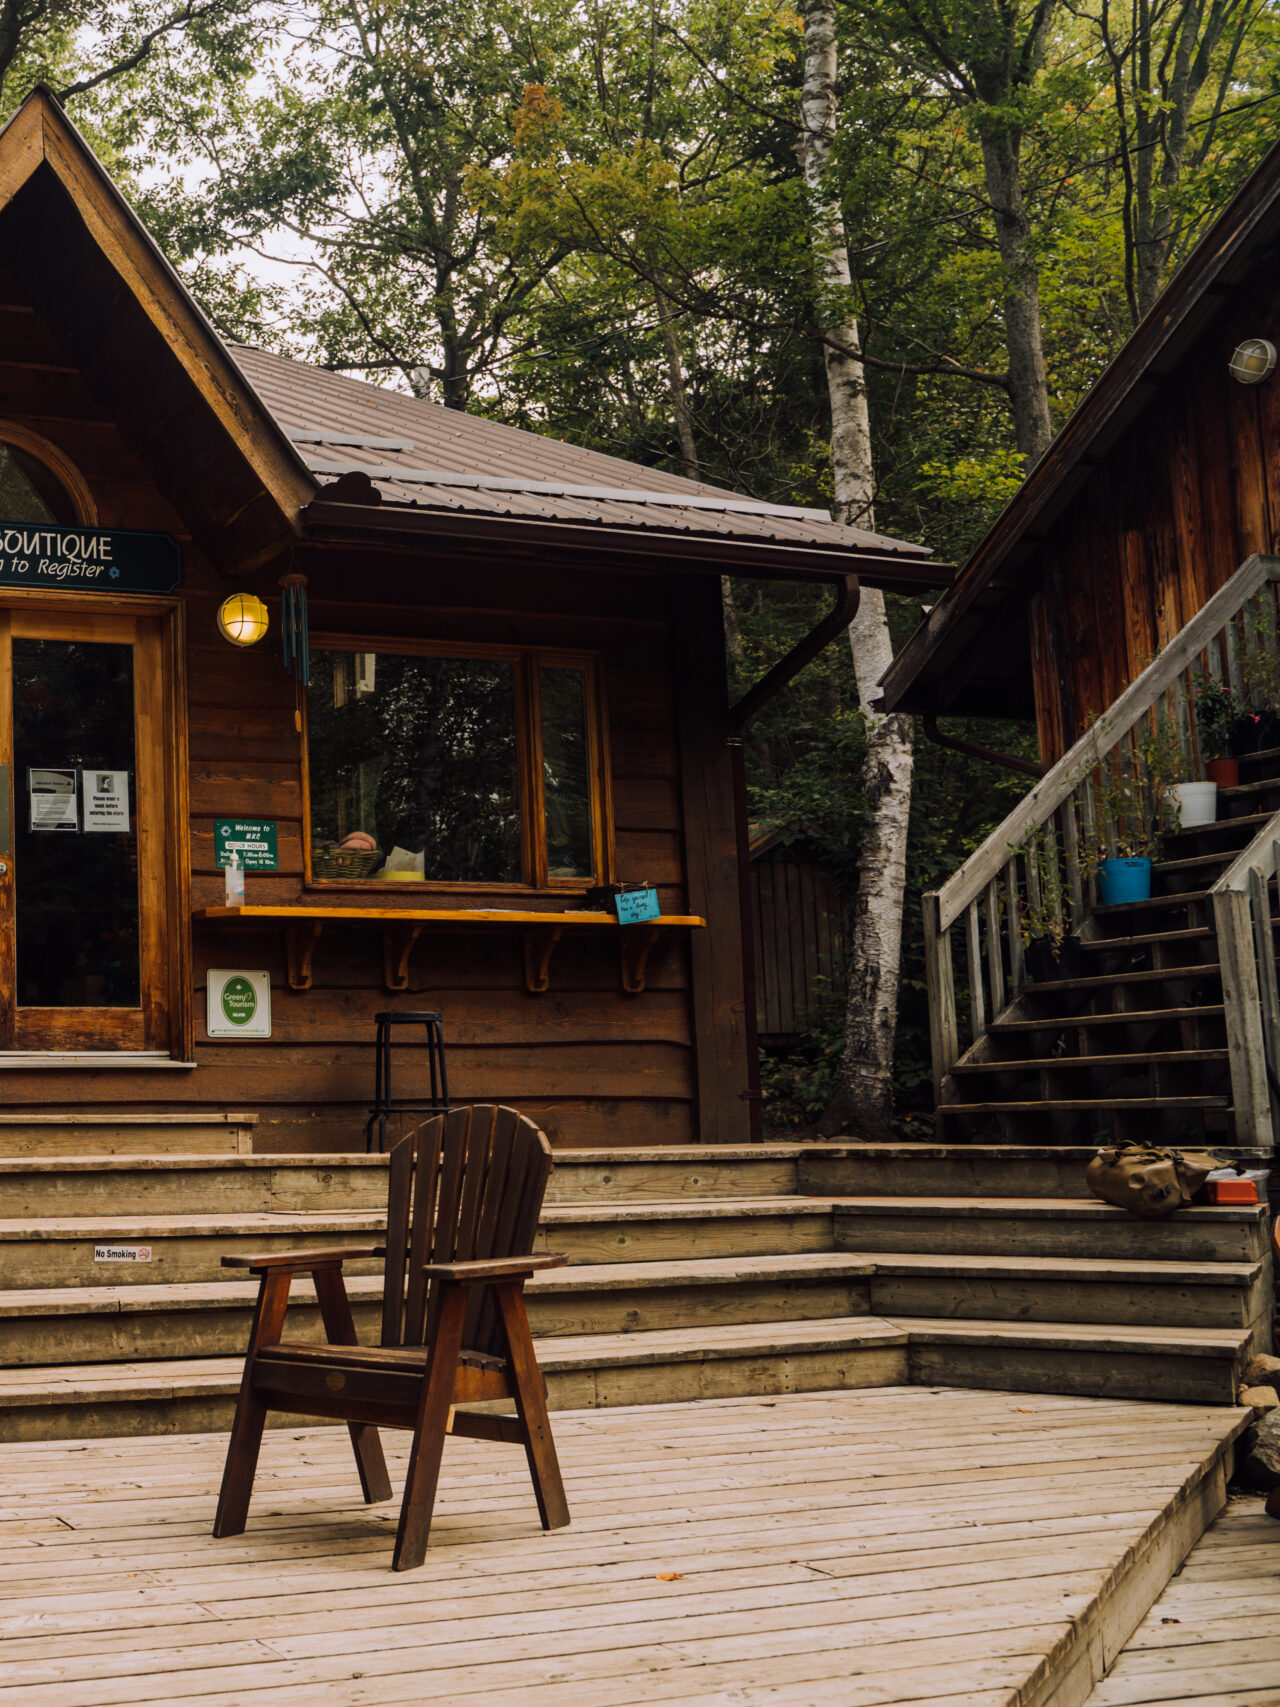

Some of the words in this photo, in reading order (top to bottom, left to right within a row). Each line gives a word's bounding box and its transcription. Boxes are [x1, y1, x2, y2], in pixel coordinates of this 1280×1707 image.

[12, 556, 29, 573] to
[37, 558, 104, 579] Register
[235, 824, 261, 832] Welcome
[224, 993, 246, 1002] Green
[229, 1000, 255, 1008] Tourism
[95, 1249, 105, 1258] No
[106, 1249, 137, 1261] Smoking
